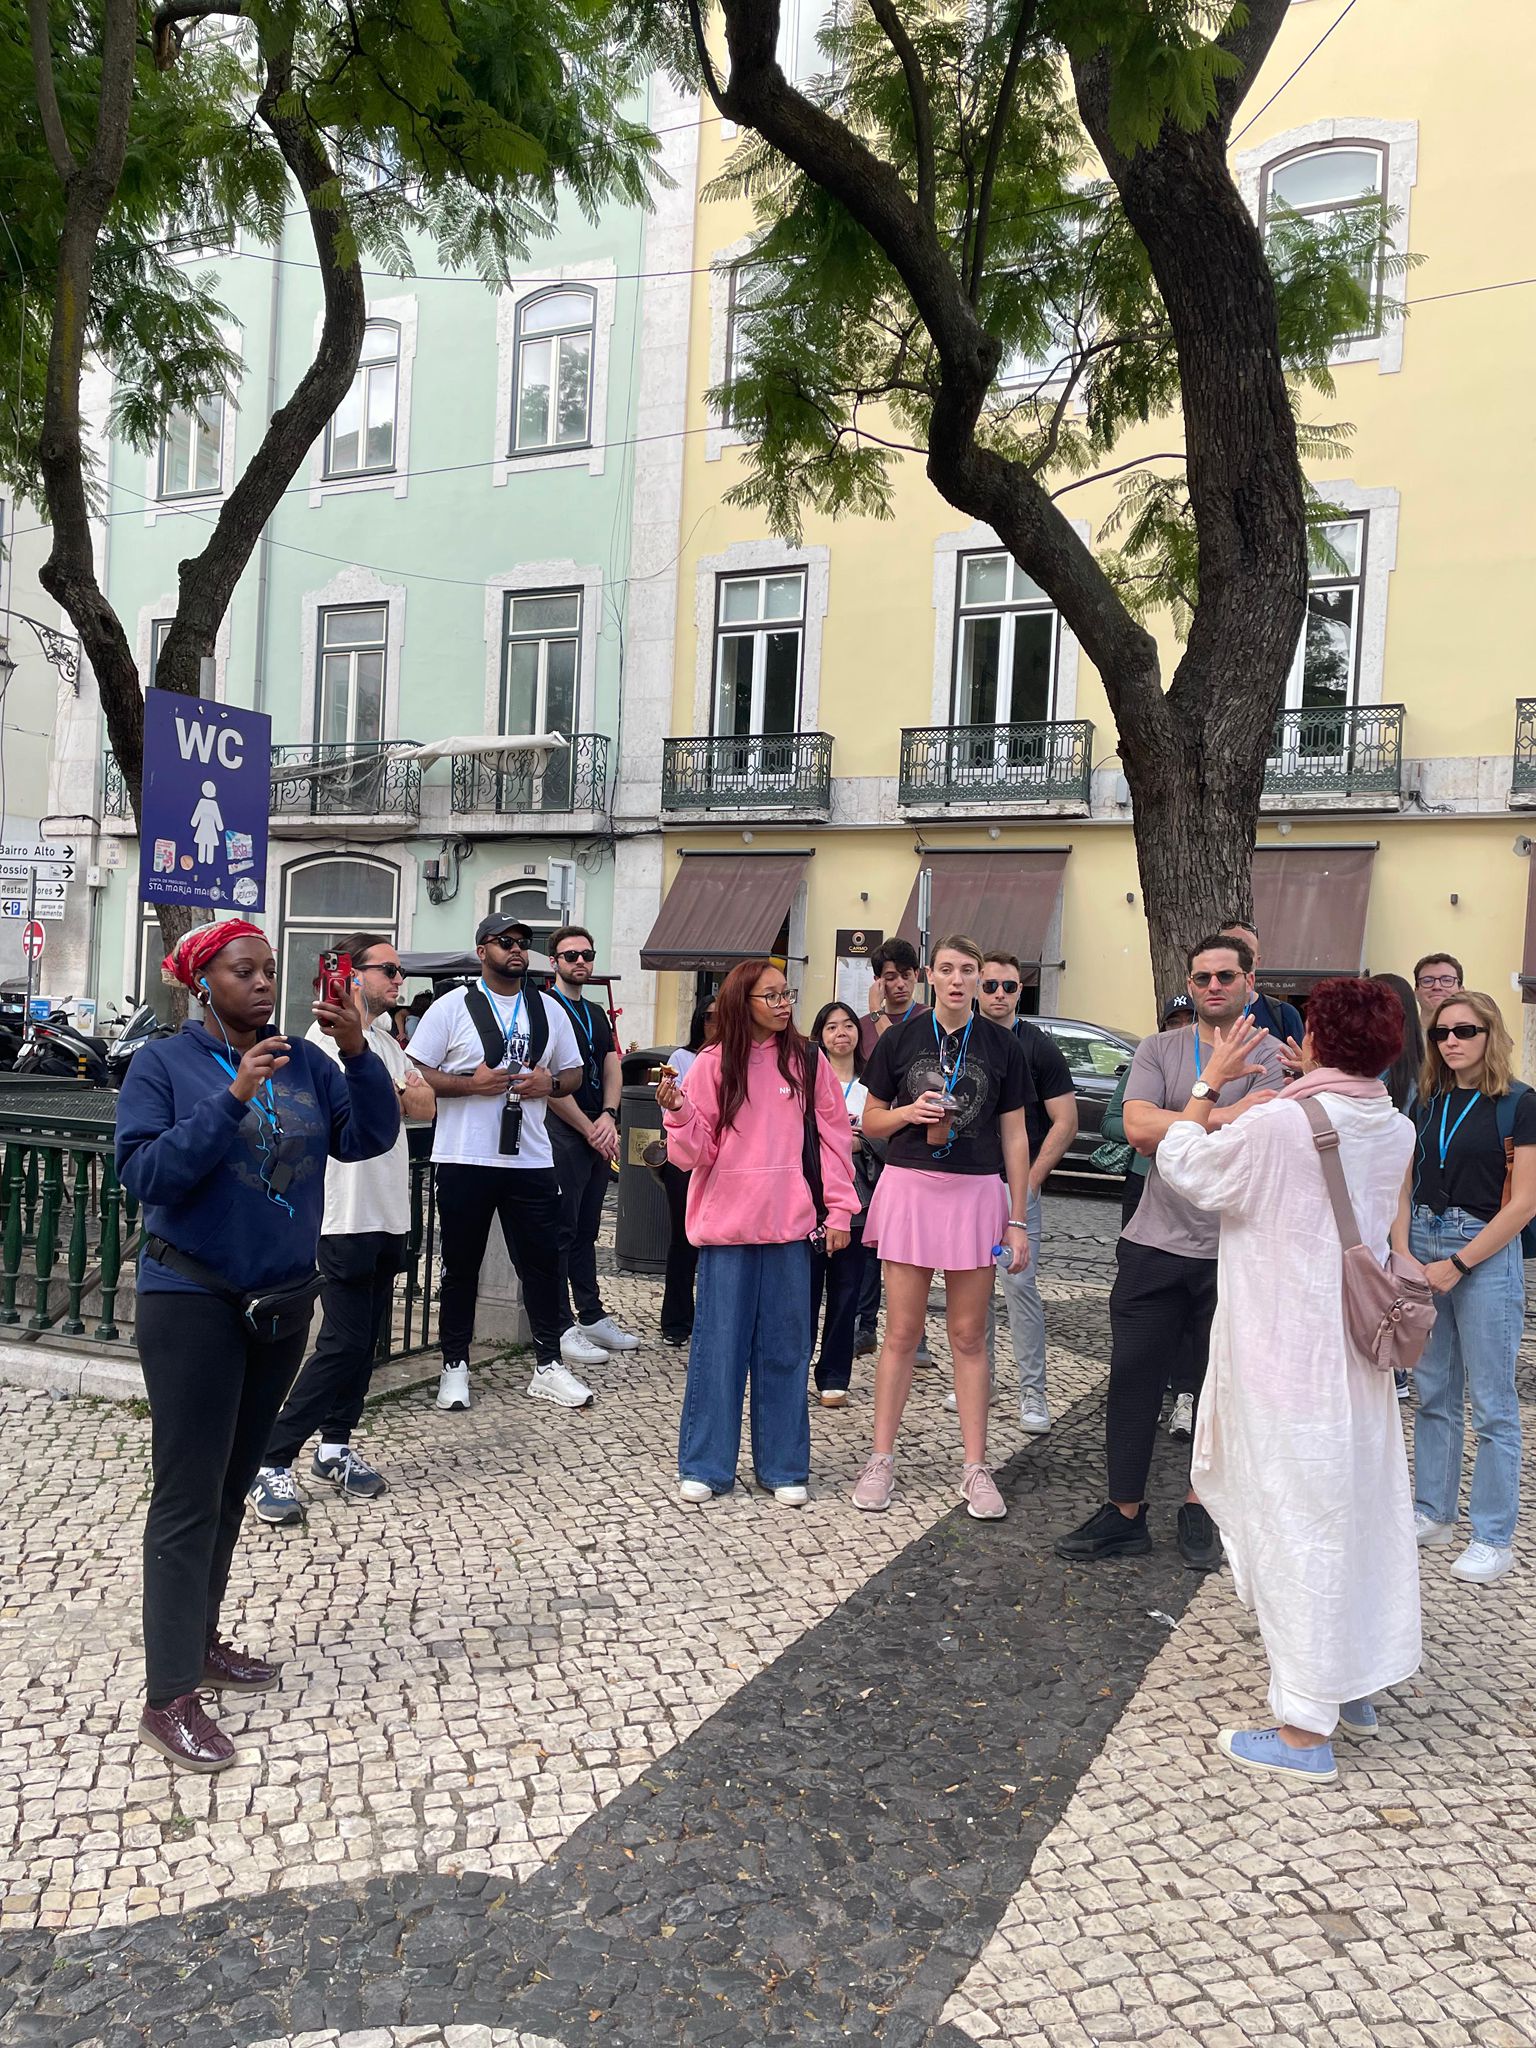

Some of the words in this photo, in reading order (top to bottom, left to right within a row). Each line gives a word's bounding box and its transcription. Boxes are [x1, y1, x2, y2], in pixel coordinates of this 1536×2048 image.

[175, 717, 244, 770] WC
[0, 845, 28, 855] Bairro
[34, 846, 55, 856] Alto
[165, 884, 192, 895] MARIA
